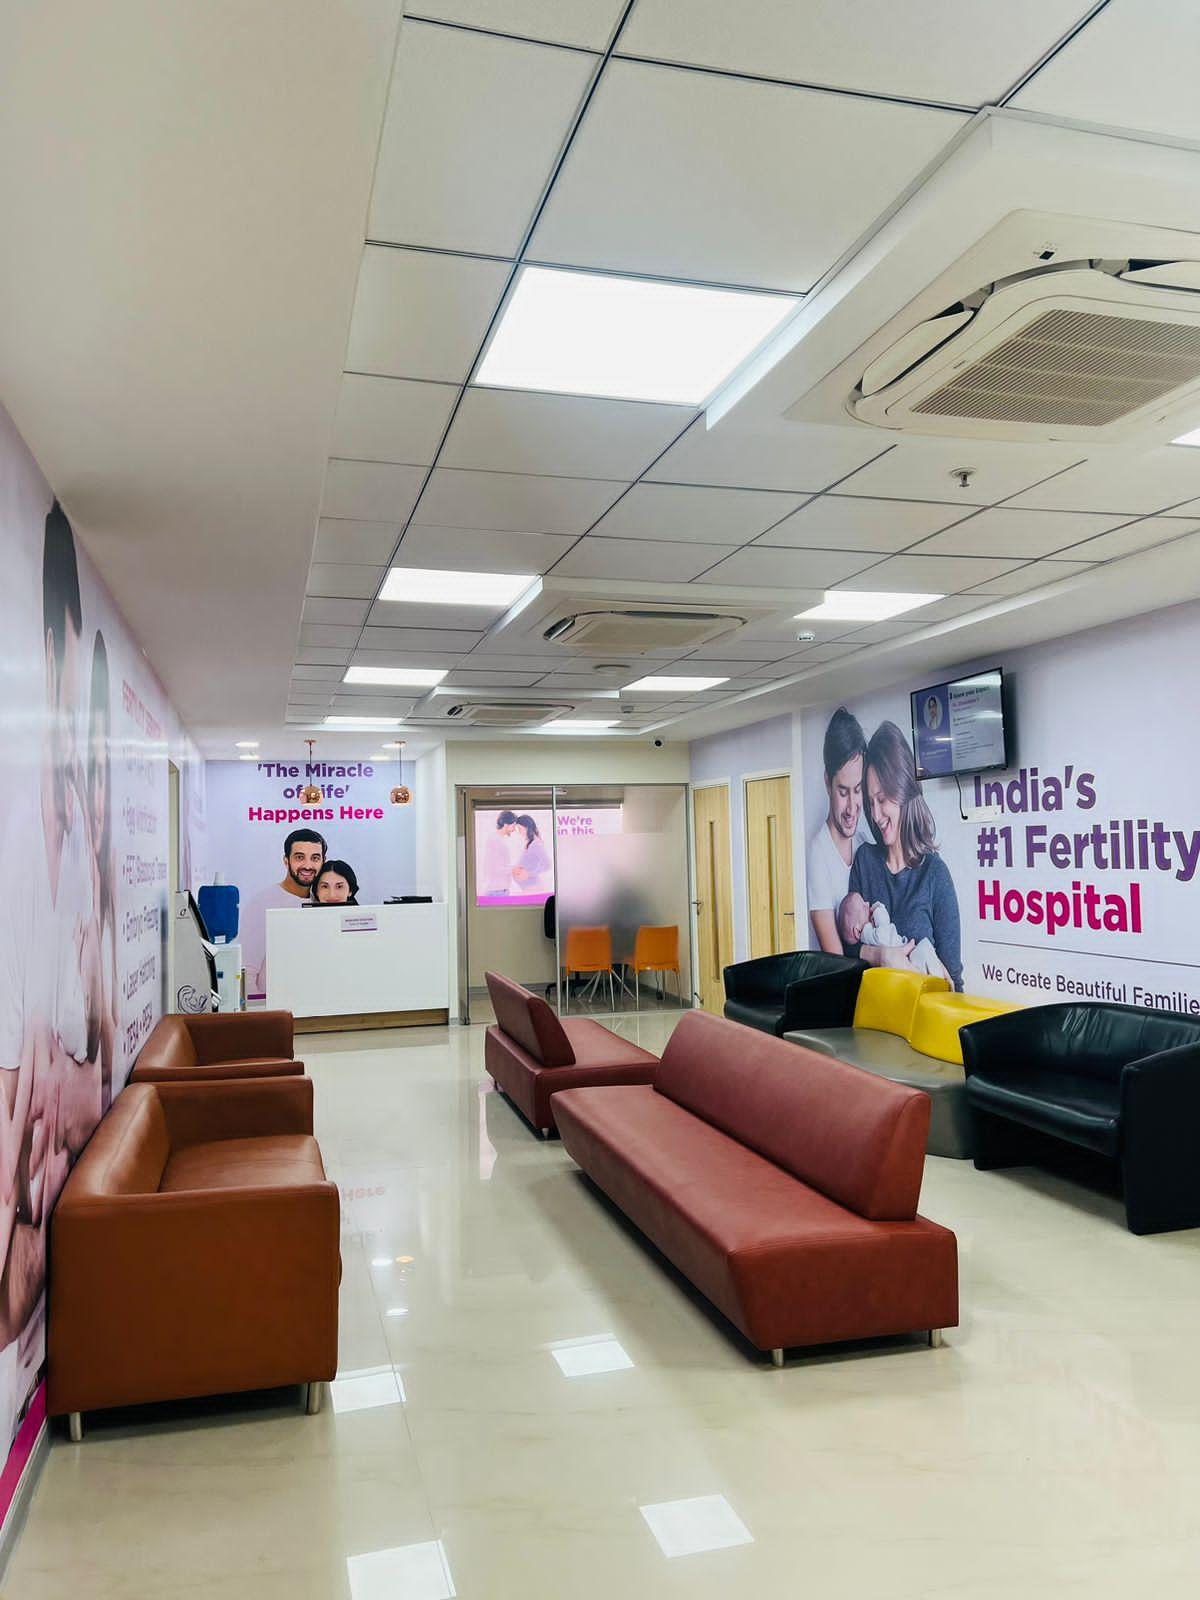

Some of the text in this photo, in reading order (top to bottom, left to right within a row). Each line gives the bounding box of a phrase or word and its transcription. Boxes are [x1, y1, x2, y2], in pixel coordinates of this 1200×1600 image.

[257, 763, 374, 777] 'The Miracle
[283, 784, 350, 799] of ife'
[974, 765, 1096, 813] India's
[248, 806, 384, 823] Happens Here
[557, 816, 592, 826] We're
[557, 826, 568, 835] in
[977, 819, 1200, 882] #1 Fertility
[978, 879, 1142, 935] Hospital
[982, 963, 1002, 981] We
[1006, 967, 1051, 990] Create
[1056, 975, 1126, 1003] Beautiful
